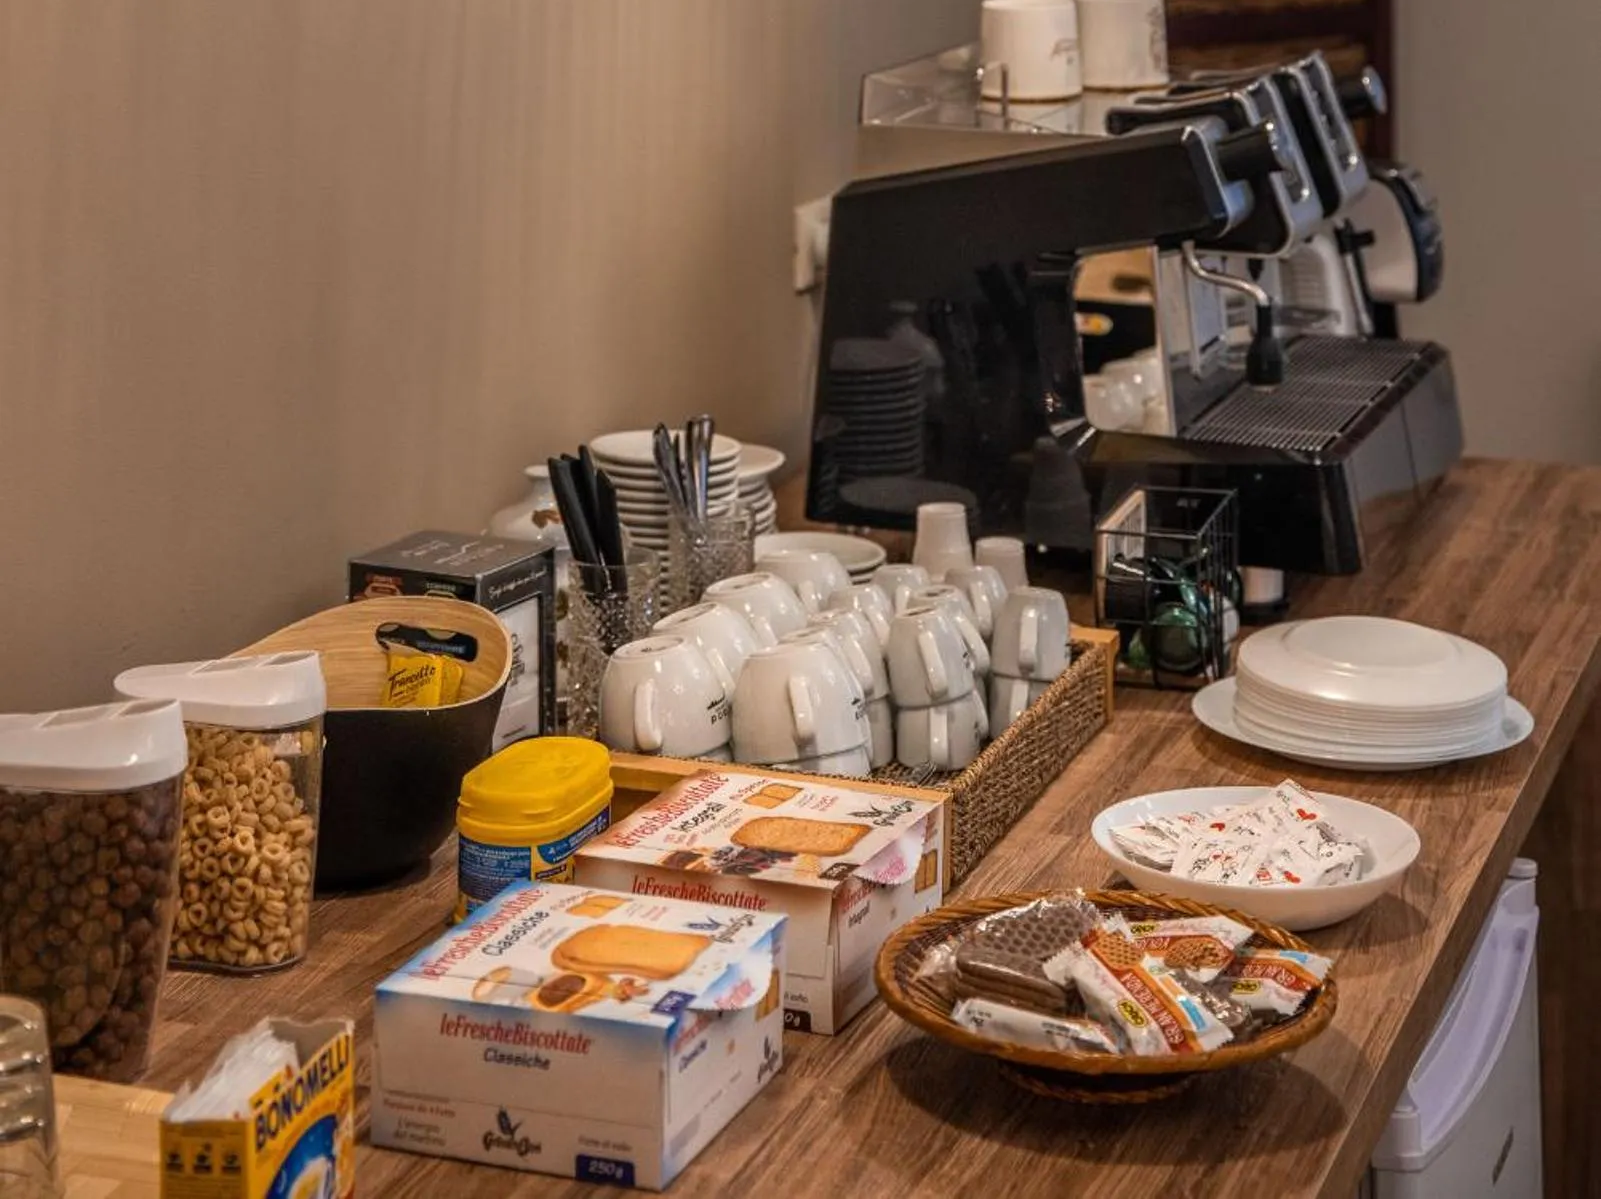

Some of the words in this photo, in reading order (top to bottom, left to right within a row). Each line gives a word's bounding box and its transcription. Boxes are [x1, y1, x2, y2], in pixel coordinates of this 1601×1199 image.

[632, 875, 768, 911] leFrescheBiscottate
[482, 910, 550, 956] Classiche
[439, 1012, 592, 1054] leFrescheBiscottate
[483, 1047, 551, 1070] Classiche
